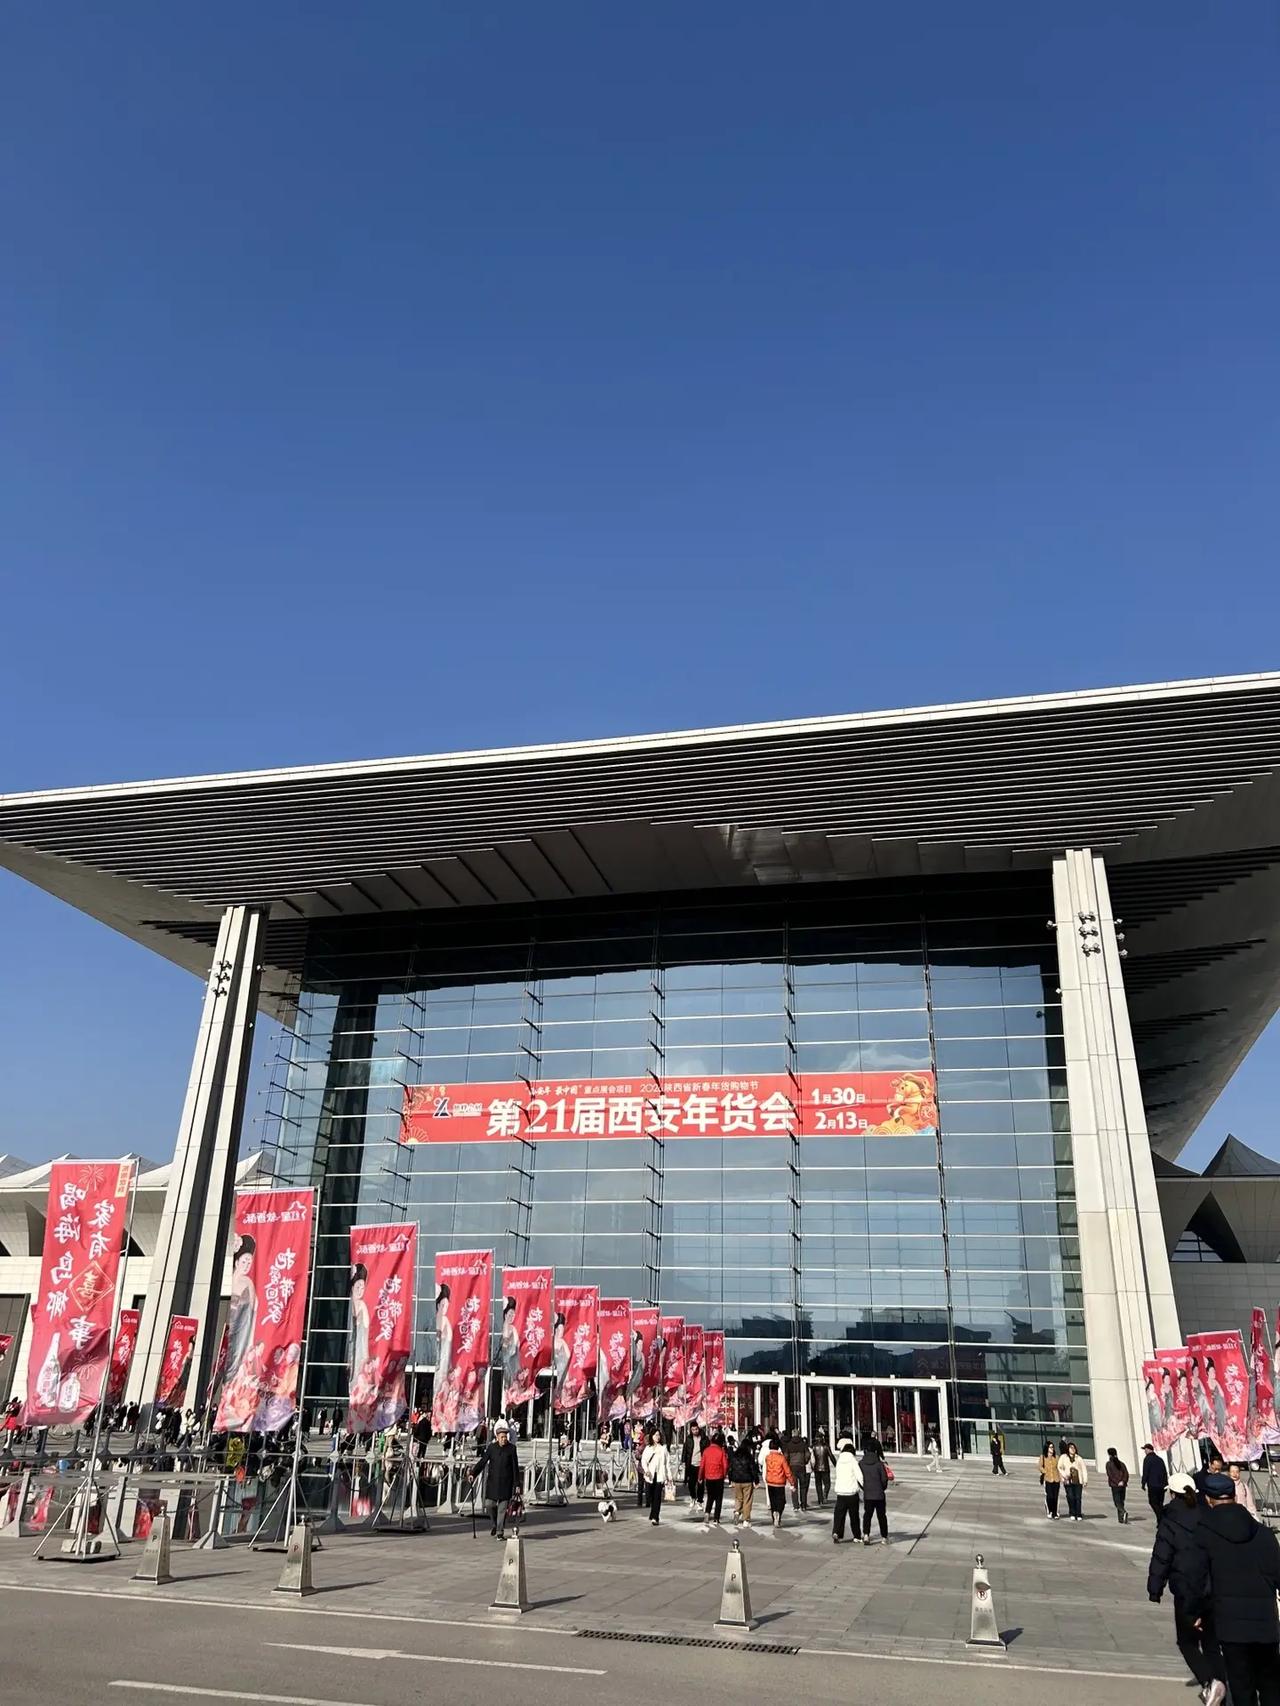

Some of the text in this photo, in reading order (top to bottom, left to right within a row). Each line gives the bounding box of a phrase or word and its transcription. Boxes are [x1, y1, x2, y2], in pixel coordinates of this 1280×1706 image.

[811, 1087, 865, 1106] 1月30日
[486, 1091, 794, 1138] 第21届西安年货会
[815, 1111, 867, 1130] 2月13日
